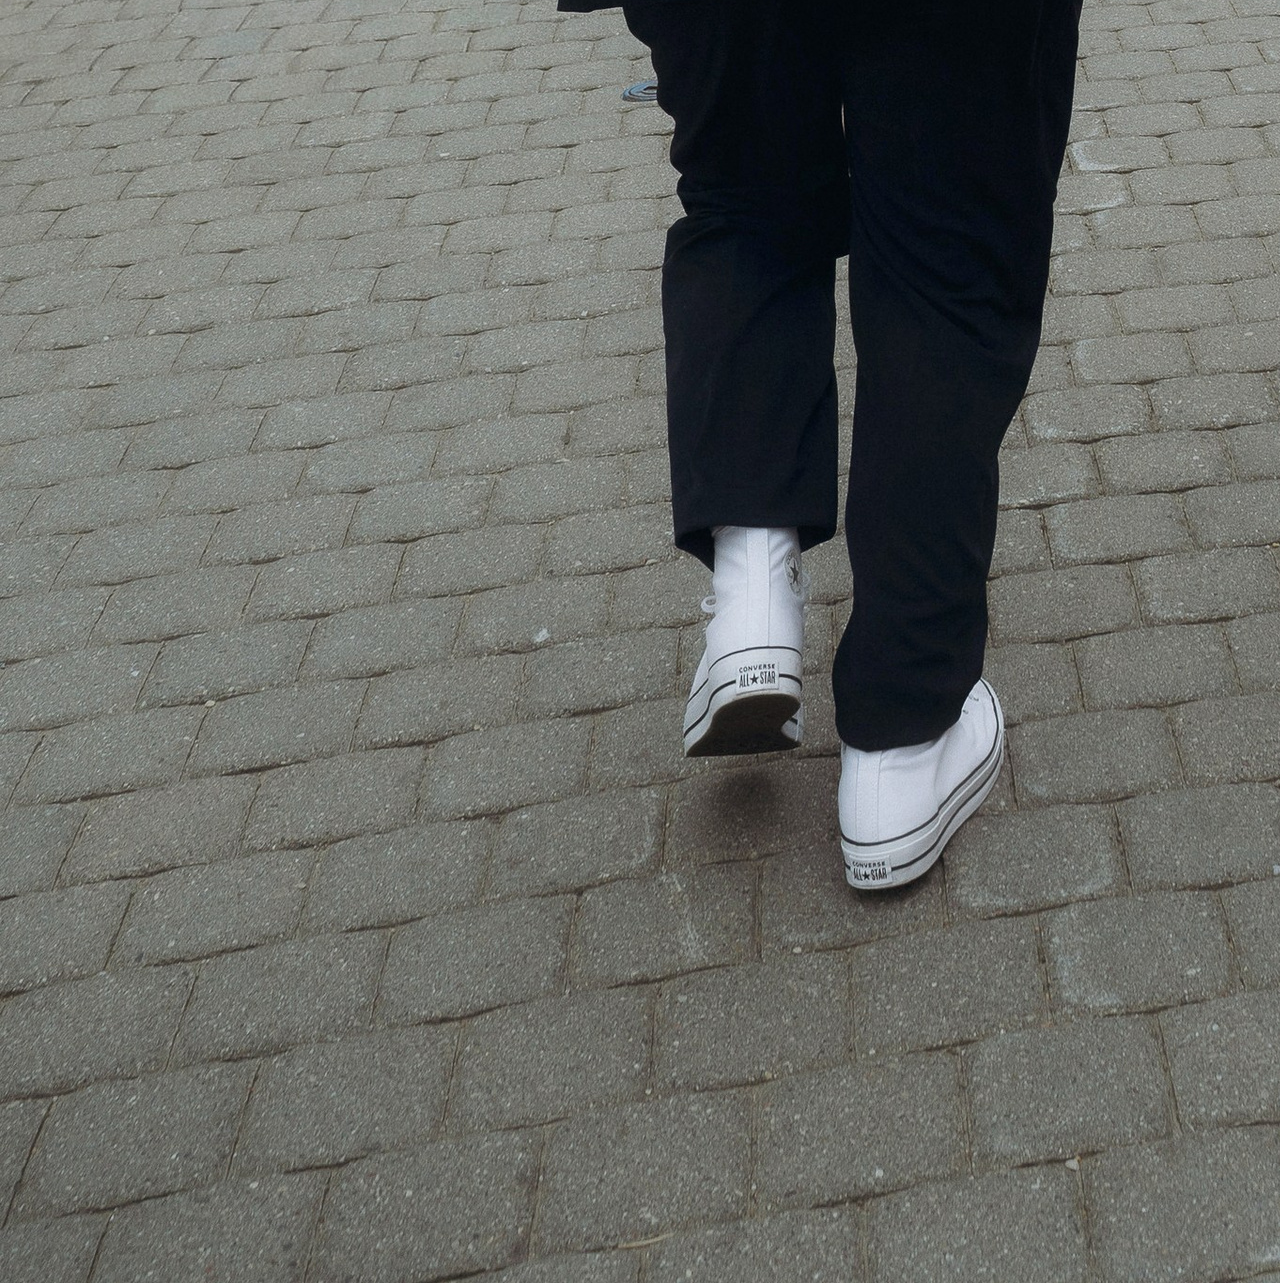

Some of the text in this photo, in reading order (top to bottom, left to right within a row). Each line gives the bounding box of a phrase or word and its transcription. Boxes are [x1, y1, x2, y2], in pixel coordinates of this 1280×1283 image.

[739, 663, 776, 673] CONVERSE
[739, 670, 776, 688] ALL STAR
[852, 860, 885, 868] CONVERSE
[853, 867, 887, 881] ALL STAR
